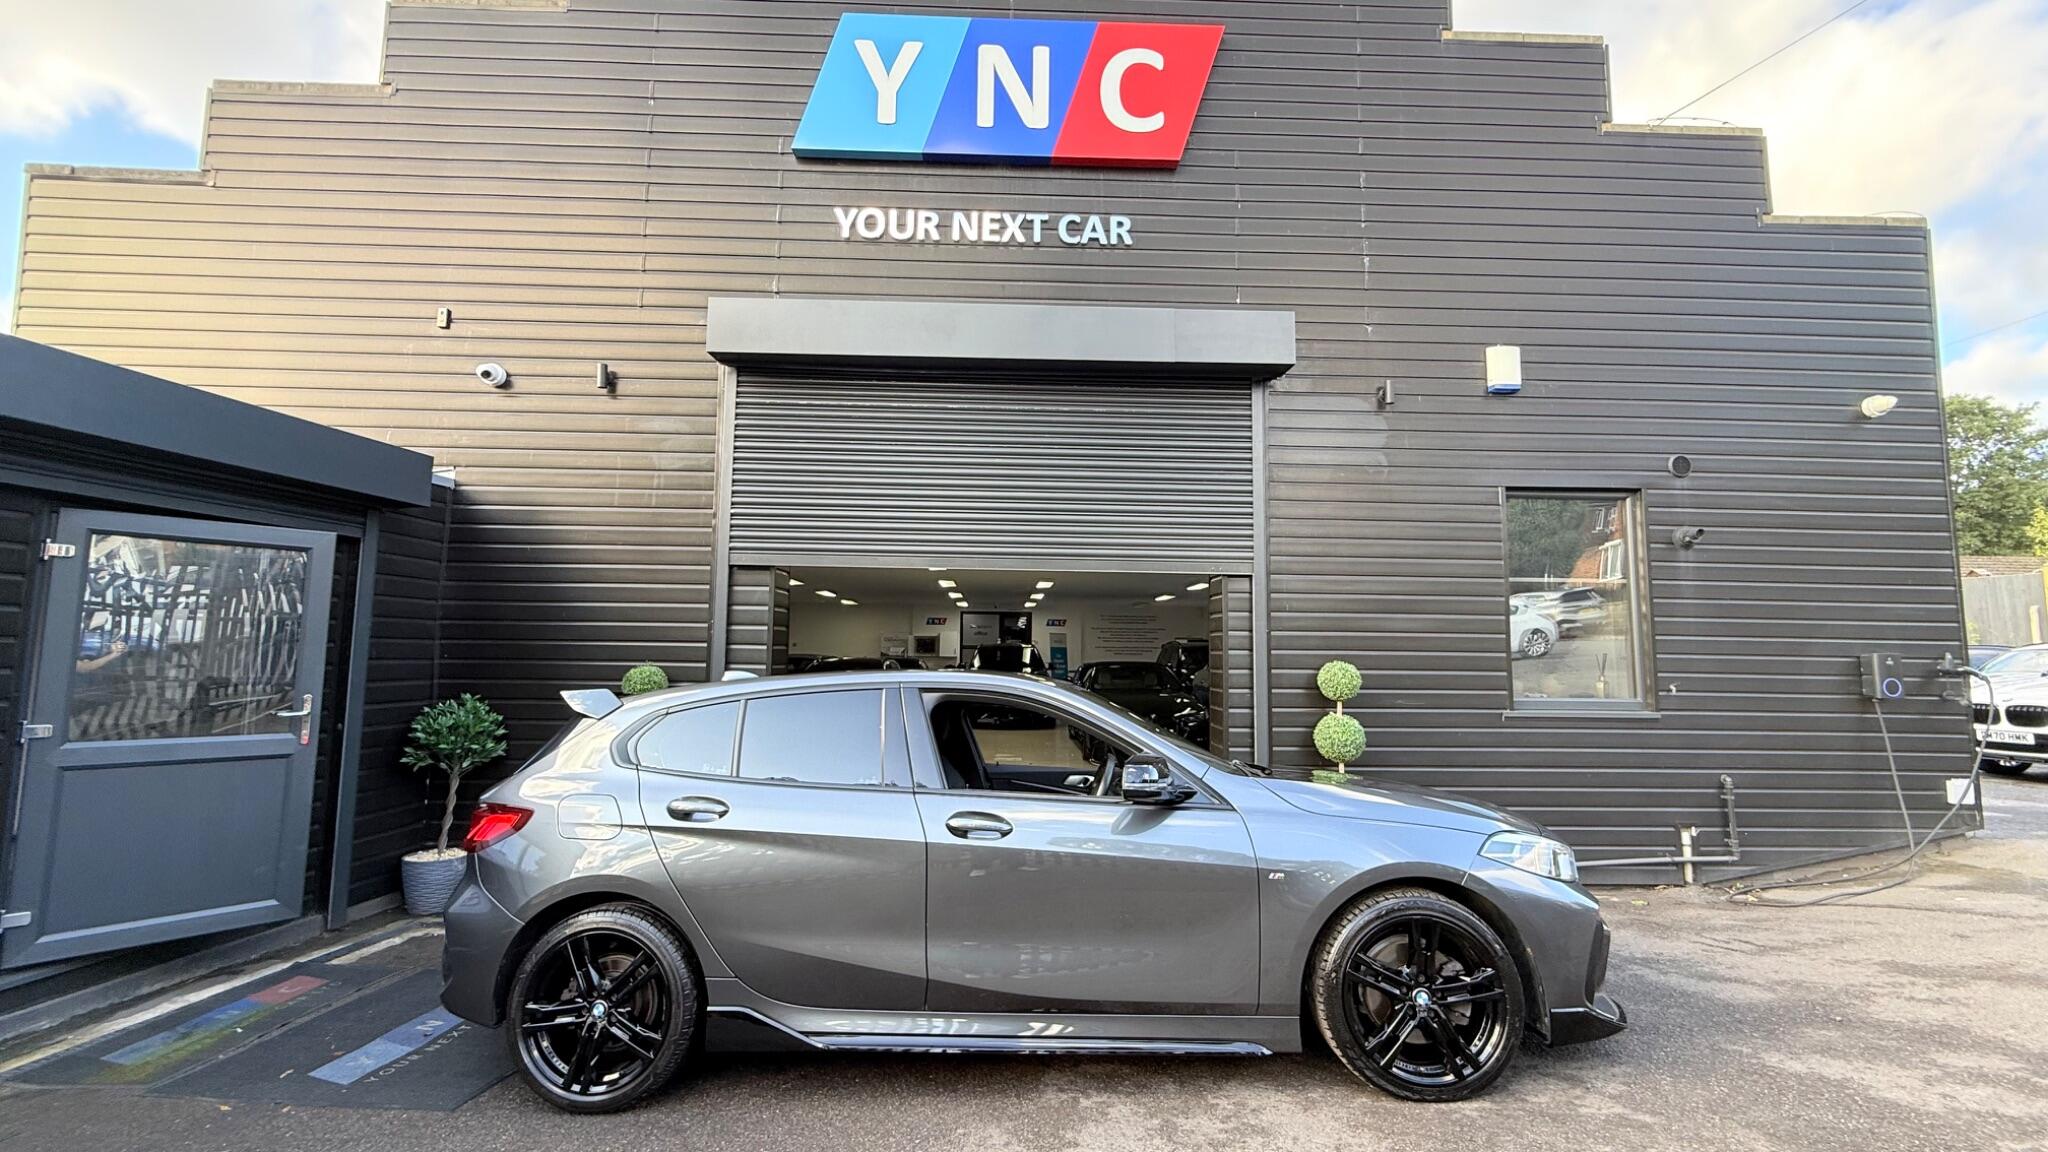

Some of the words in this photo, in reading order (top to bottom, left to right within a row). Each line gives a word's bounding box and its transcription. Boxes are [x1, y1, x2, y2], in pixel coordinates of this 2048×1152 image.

[853, 39, 1165, 133] YNC
[833, 207, 940, 241] YOUR
[951, 211, 1048, 244] NEXT
[1058, 215, 1134, 246] CAR
[363, 1053, 424, 1083] YOUR
[424, 1024, 472, 1051] NEXT
